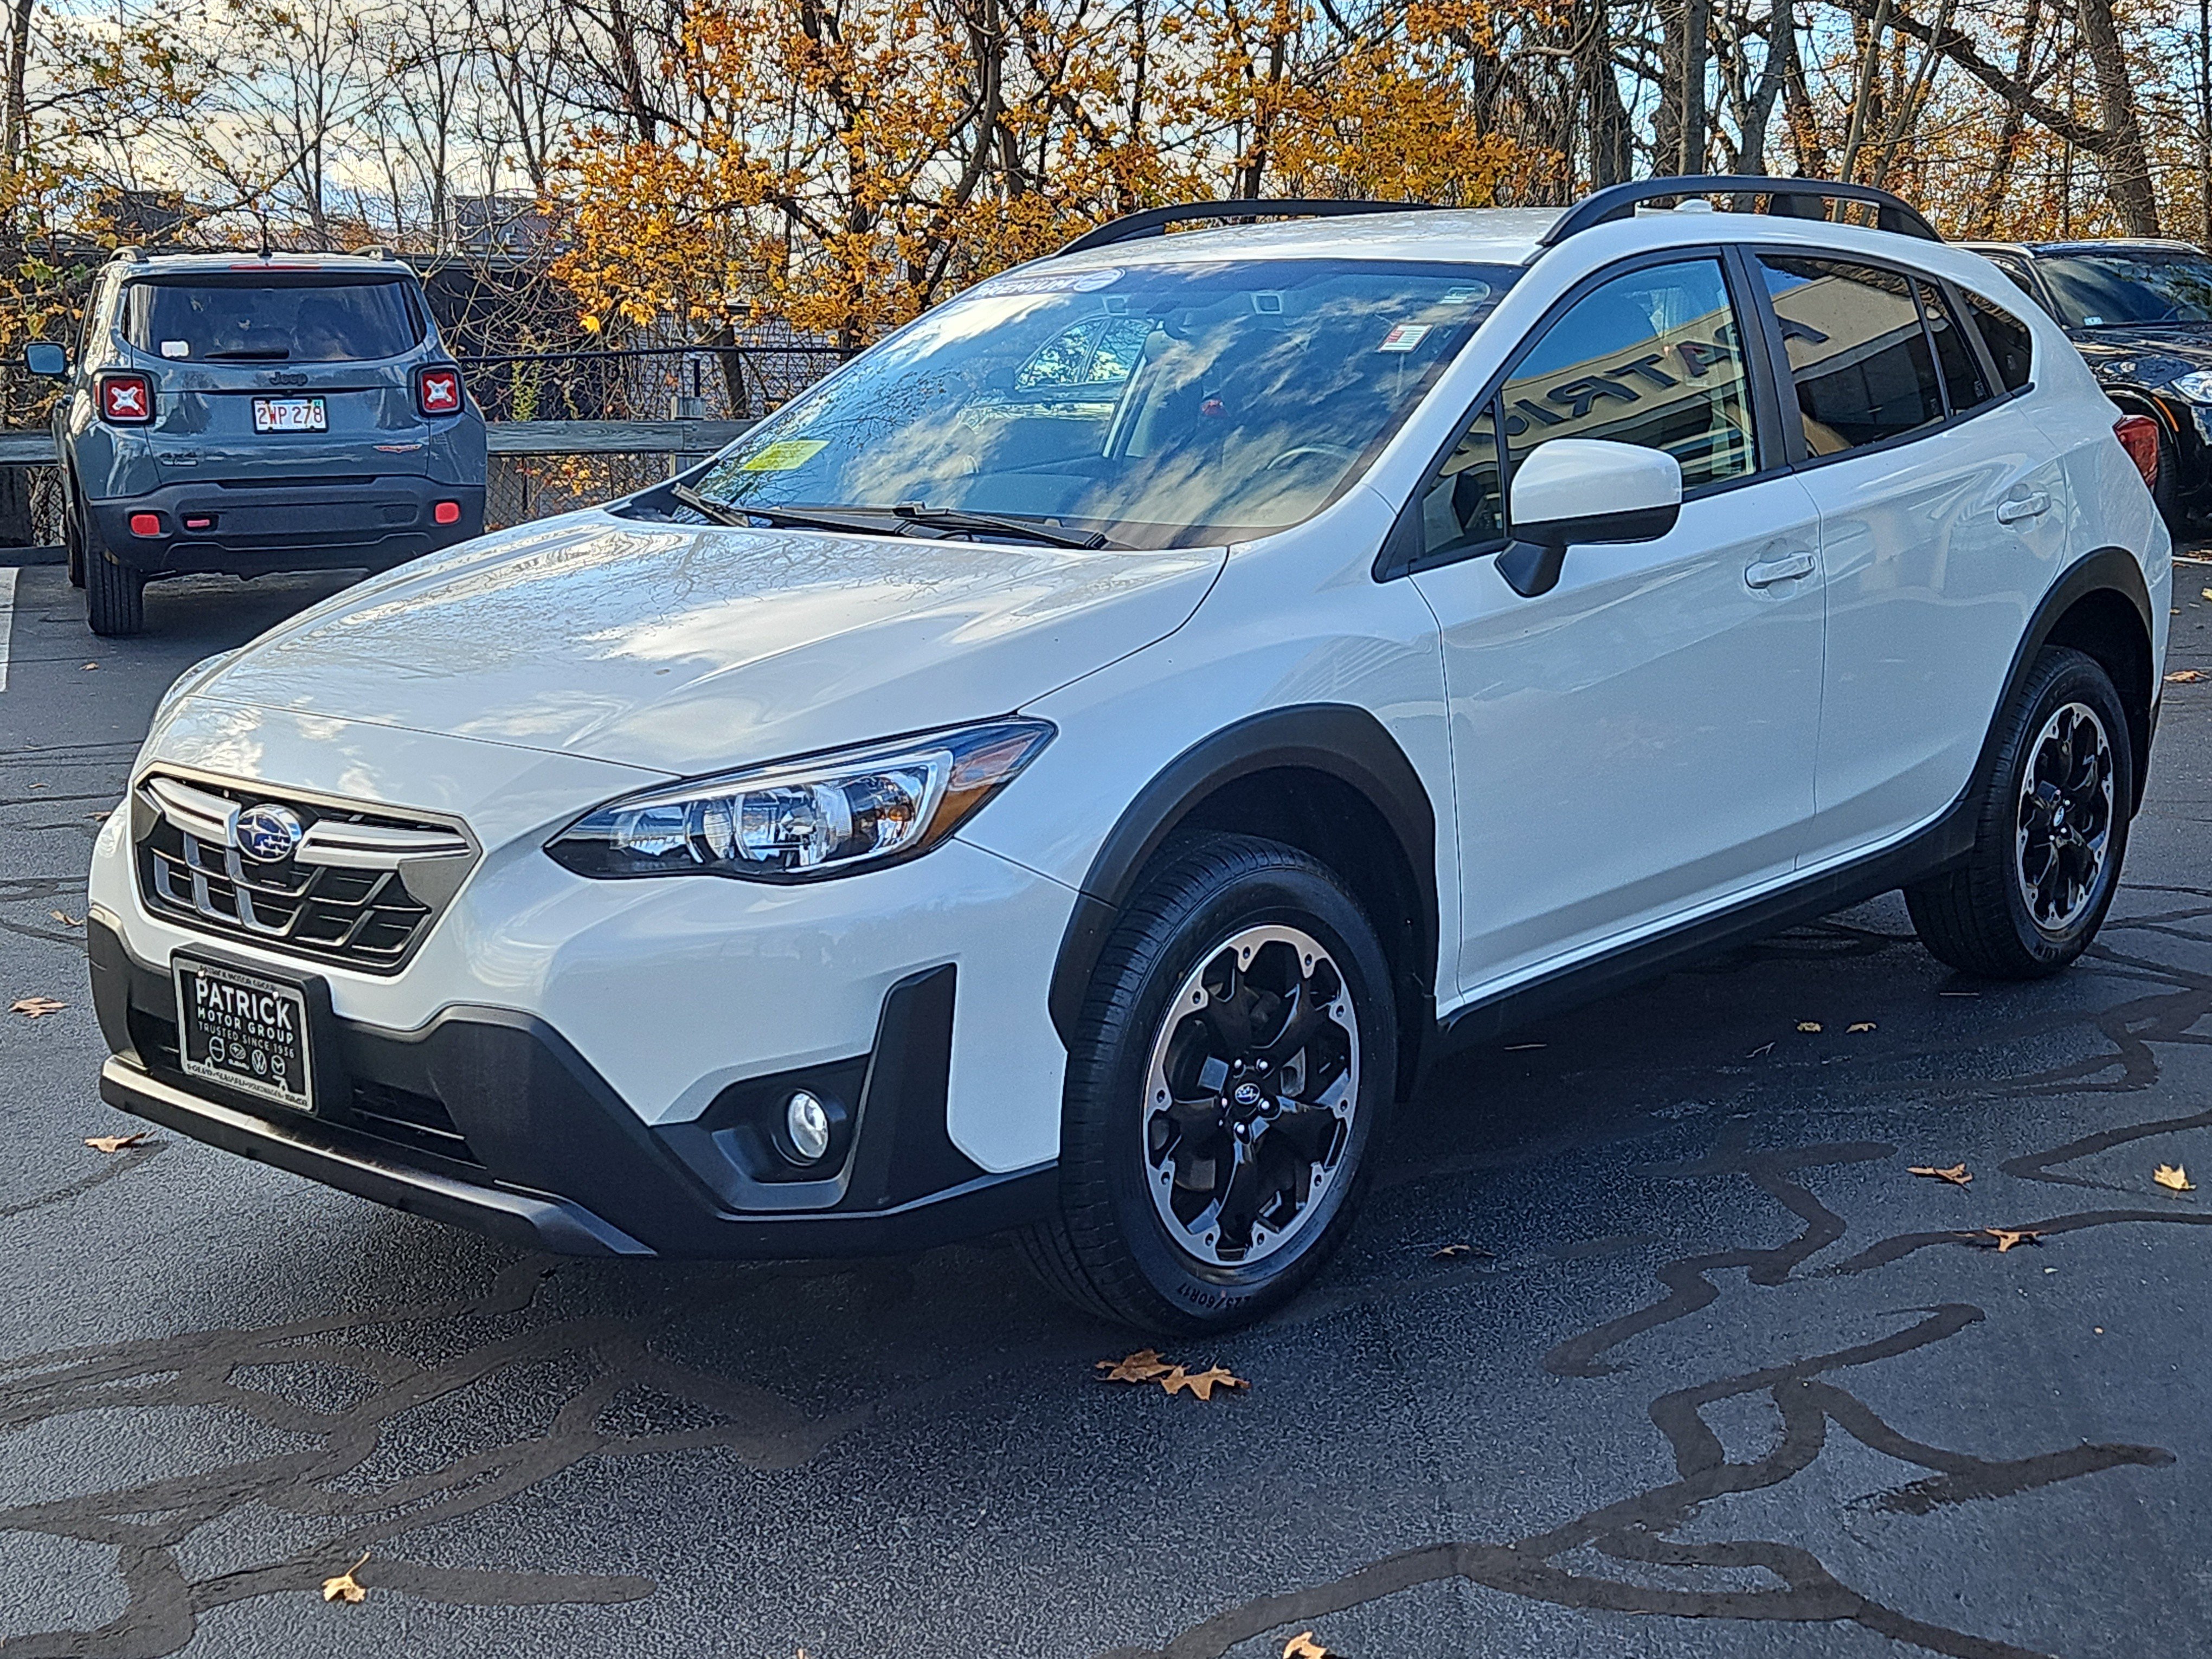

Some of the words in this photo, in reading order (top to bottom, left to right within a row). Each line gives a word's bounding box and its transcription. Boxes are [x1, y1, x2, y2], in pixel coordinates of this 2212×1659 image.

[269, 372, 308, 386] Jeep
[292, 406, 323, 424] 278
[195, 978, 292, 1030] PATRICK
[197, 1006, 241, 1030] MOTOR
[248, 1021, 293, 1044] GROUP
[198, 1021, 239, 1041] TRUSTED
[242, 1034, 270, 1051] SINCE
